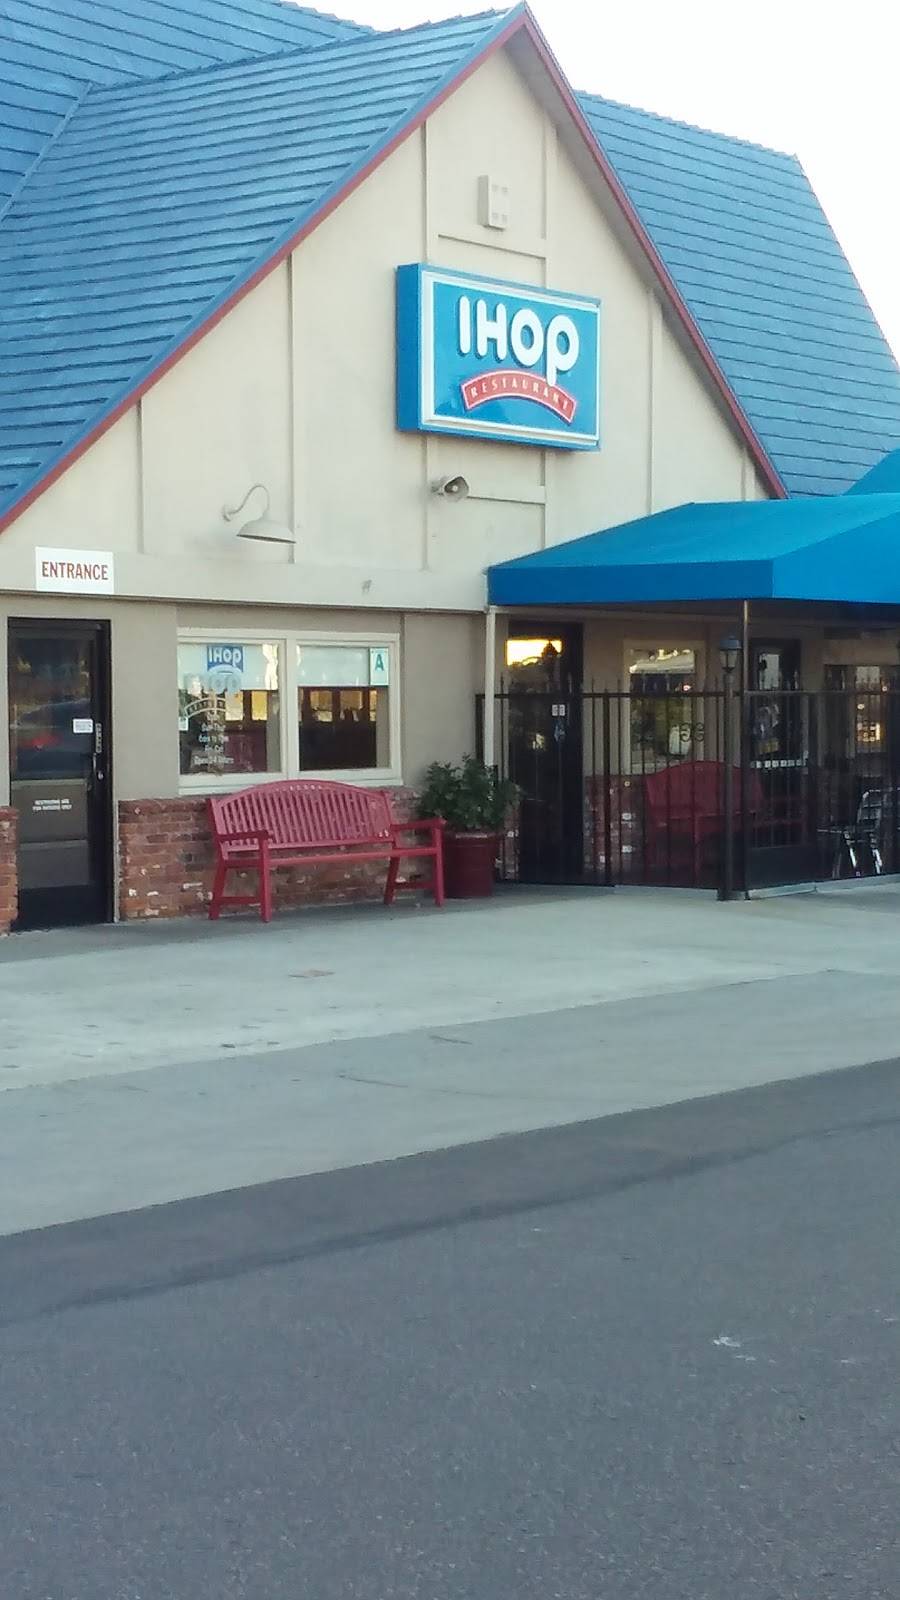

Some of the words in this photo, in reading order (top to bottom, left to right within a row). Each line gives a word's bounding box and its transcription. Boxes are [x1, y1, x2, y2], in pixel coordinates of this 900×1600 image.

[459, 295, 580, 387] IHOP
[470, 377, 569, 412] RESTAURANT
[42, 561, 108, 580] ENTRANCE
[208, 646, 242, 667] IHOP
[375, 653, 384, 671] A
